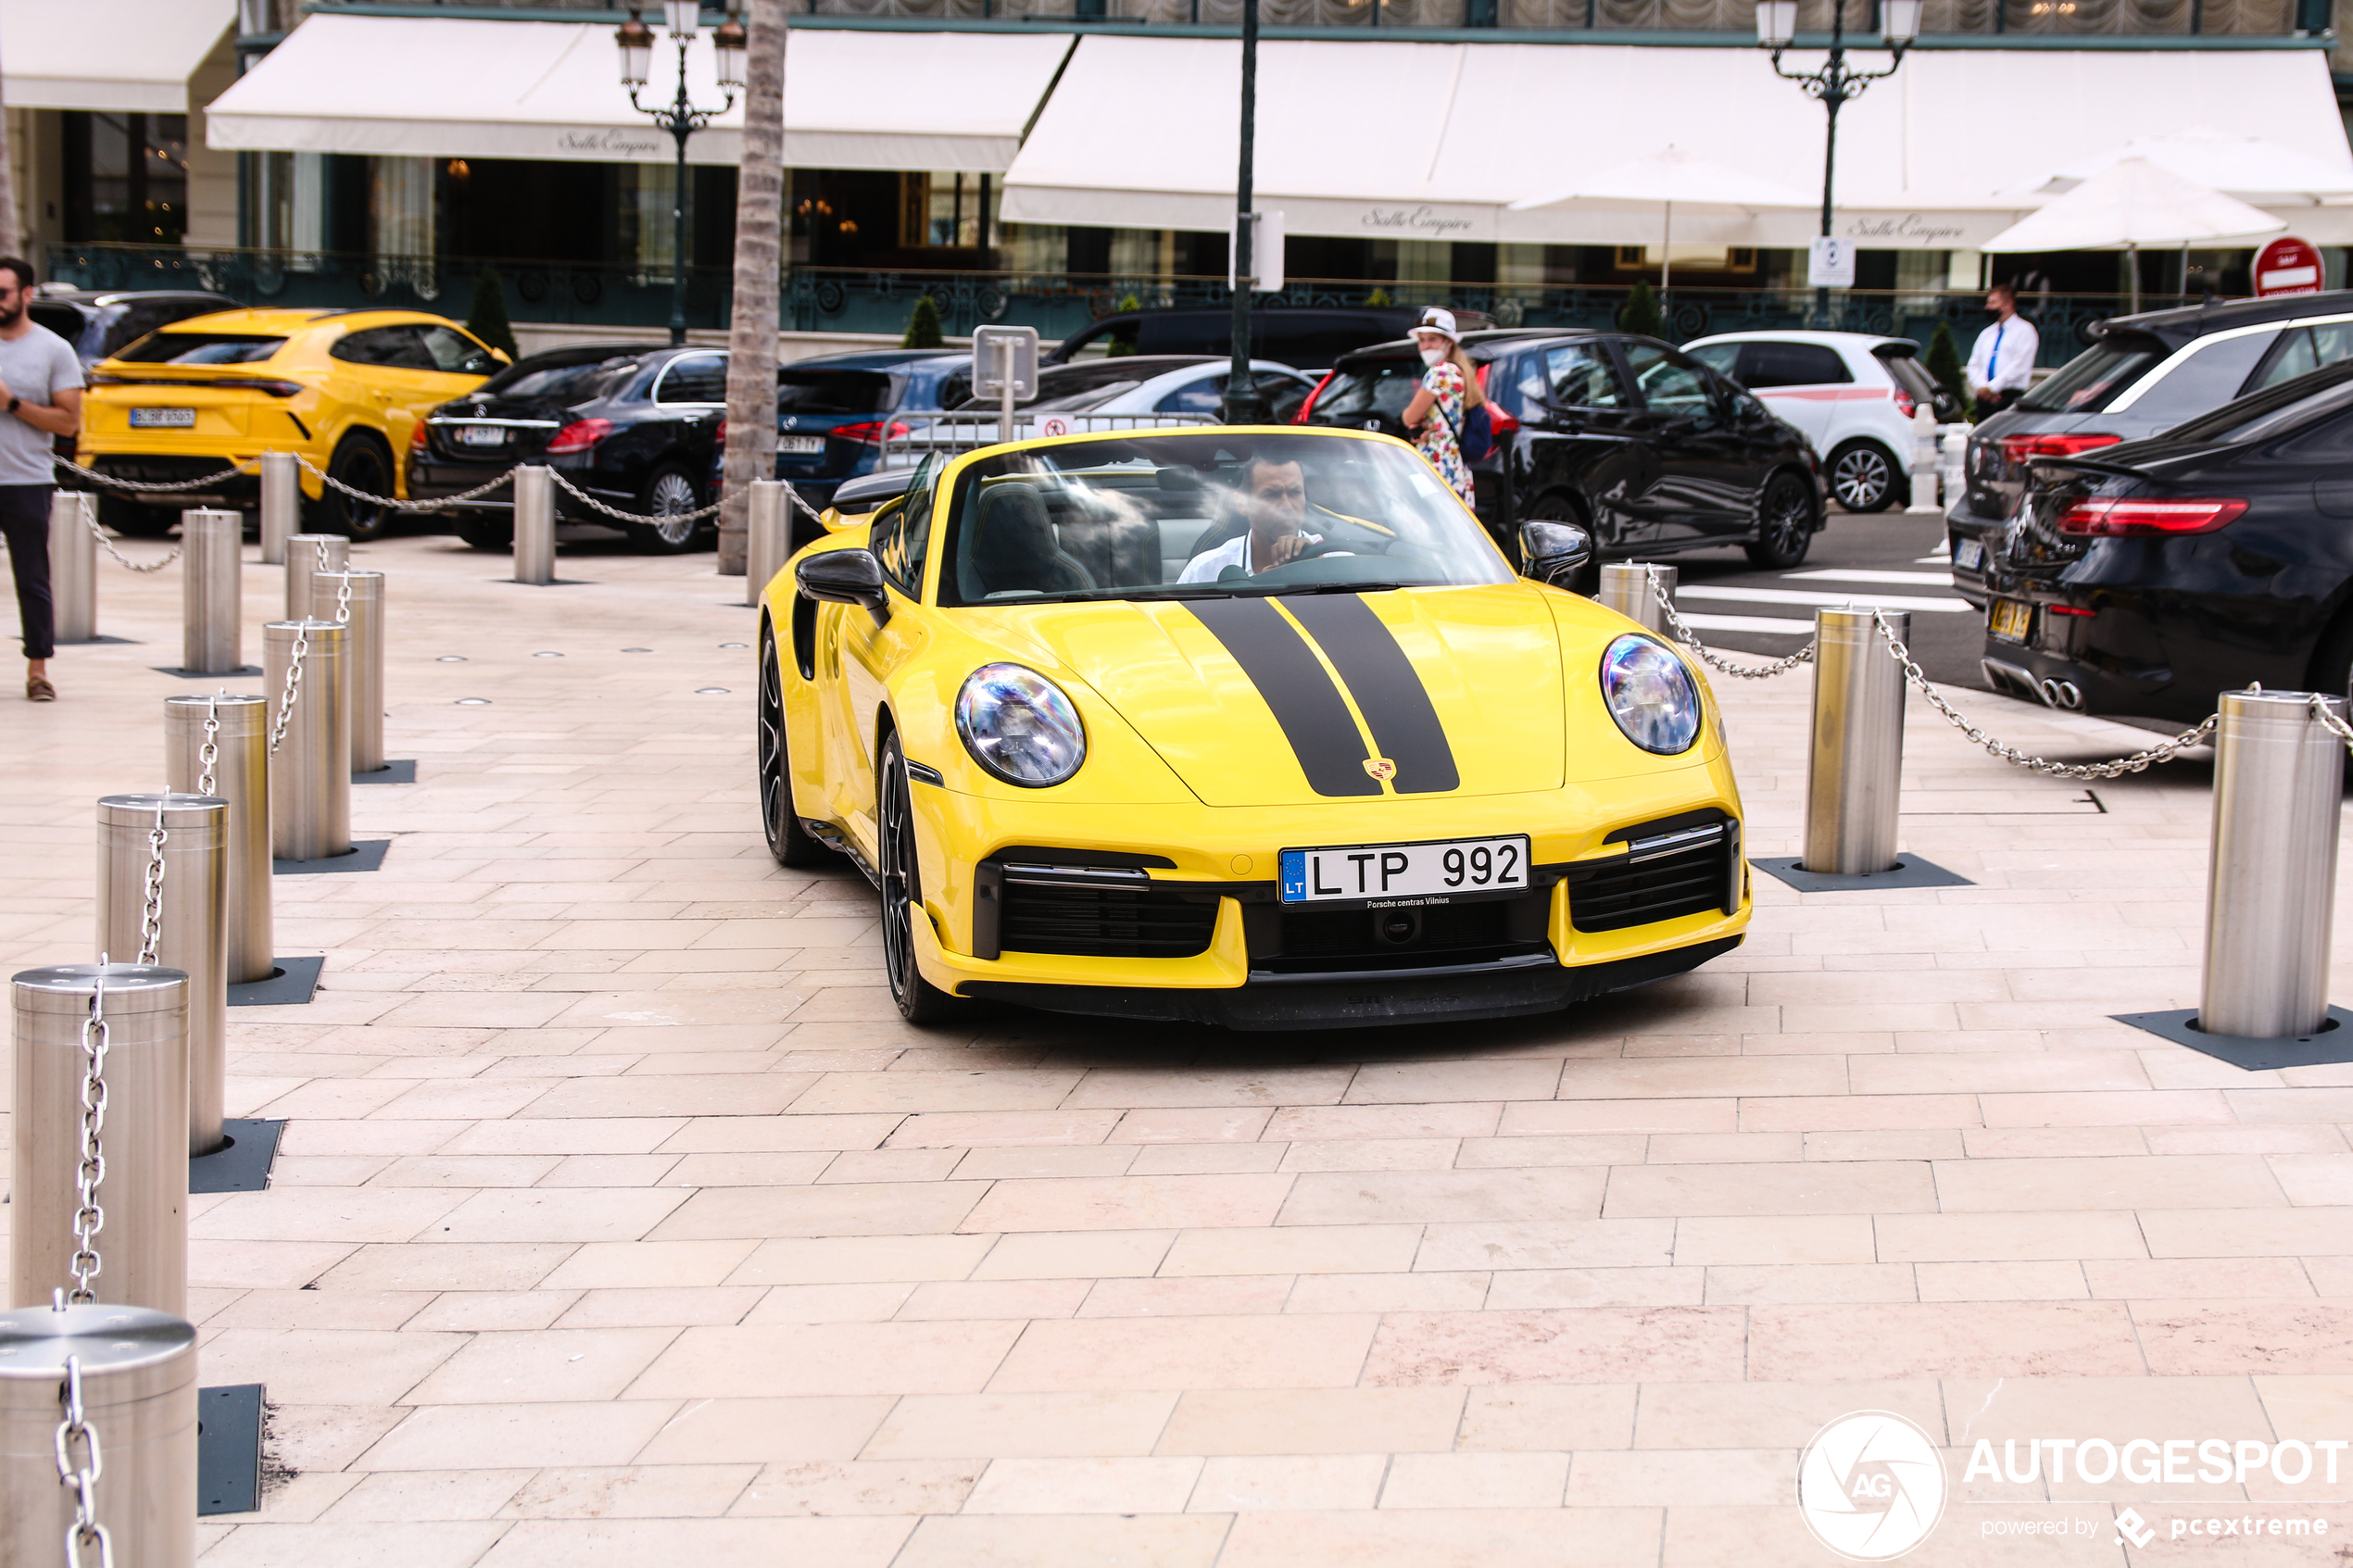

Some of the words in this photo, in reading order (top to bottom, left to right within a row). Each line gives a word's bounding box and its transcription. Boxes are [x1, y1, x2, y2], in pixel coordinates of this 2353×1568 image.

[558, 131, 598, 150] Salle
[600, 128, 660, 157] Empire
[1361, 207, 1407, 228] Salle
[1409, 205, 1473, 236] Empire
[1847, 217, 1894, 237] Salle
[1897, 212, 1965, 246] Empire
[1314, 852, 1409, 896] LTP
[1442, 844, 1519, 887] 992
[1285, 882, 1304, 895] LT
[1366, 899, 1396, 909] Porsche
[1397, 898, 1425, 907] centras
[1426, 896, 1450, 906] Vilnius
